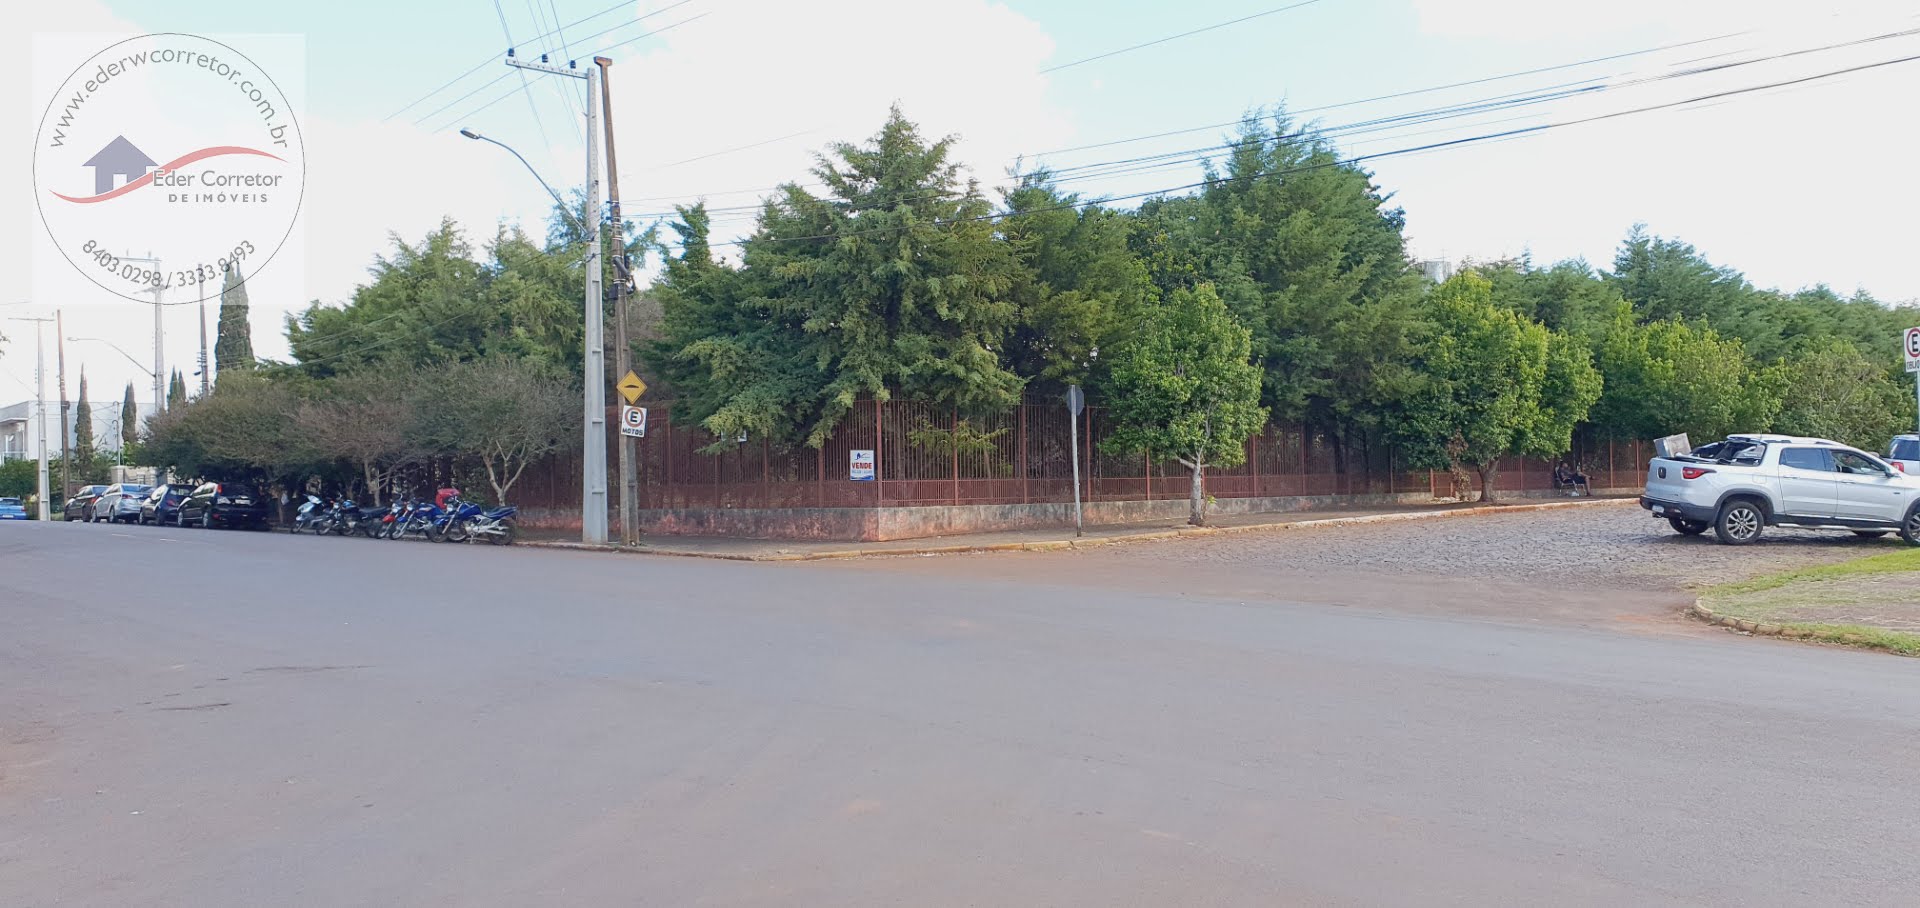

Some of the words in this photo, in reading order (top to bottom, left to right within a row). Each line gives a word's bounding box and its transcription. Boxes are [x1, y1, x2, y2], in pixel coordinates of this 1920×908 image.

[1912, 333, 1918, 352] E
[630, 411, 638, 423] E
[622, 427, 643, 436] MOTOS
